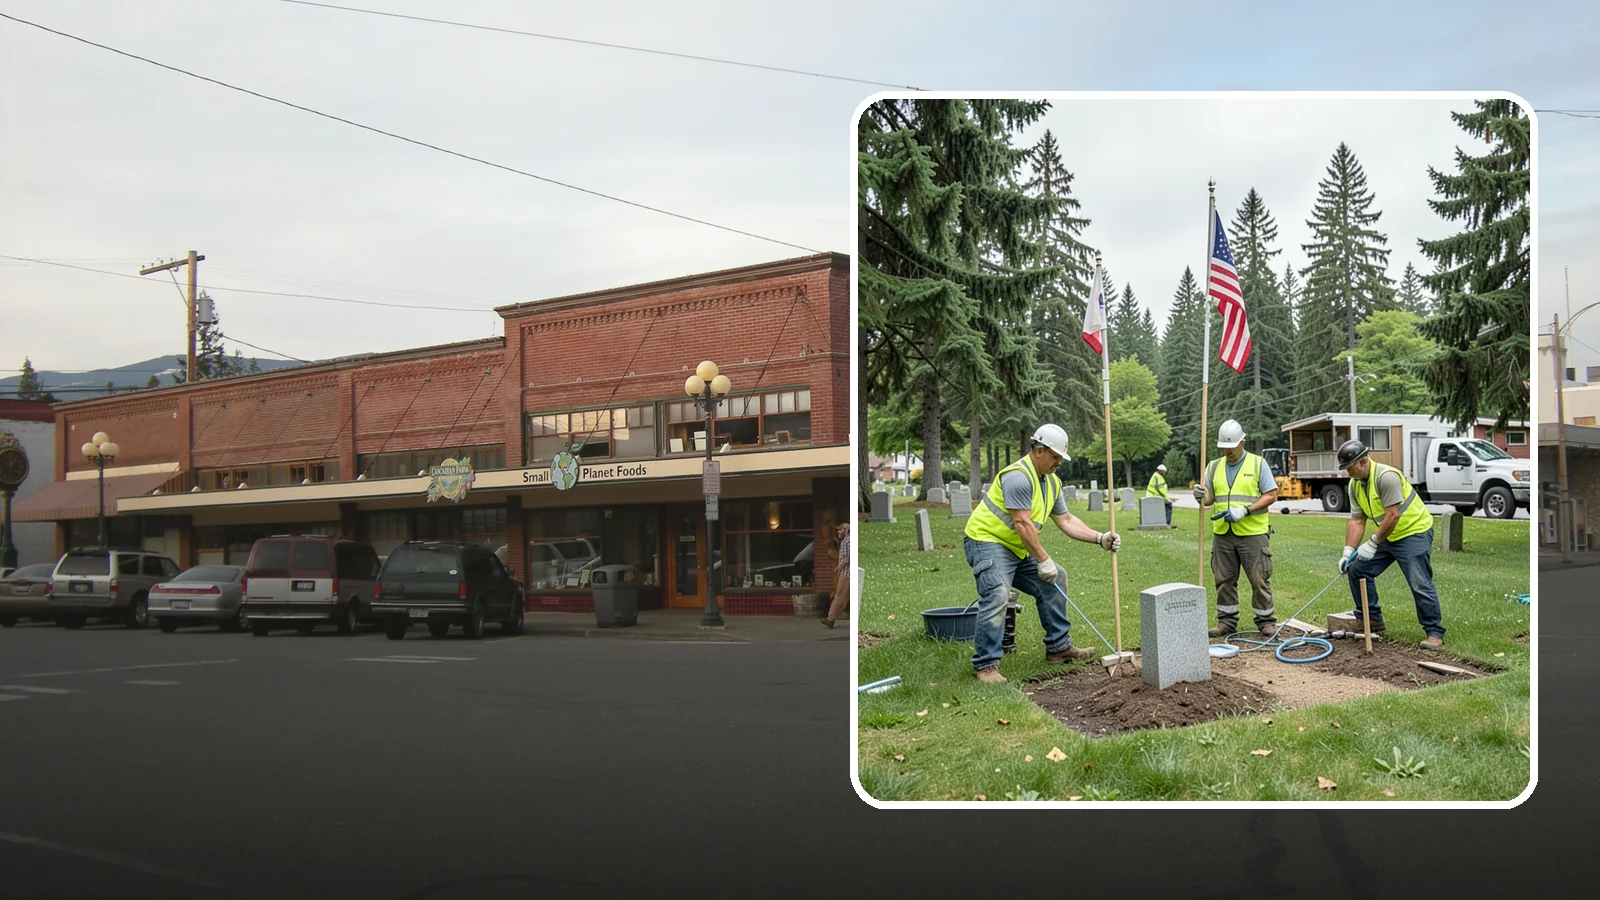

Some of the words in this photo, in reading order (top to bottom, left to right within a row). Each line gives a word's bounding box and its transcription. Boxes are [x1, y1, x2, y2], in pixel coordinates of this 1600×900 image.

[523, 471, 549, 483] Small
[583, 467, 614, 479] Planet
[617, 464, 647, 477] Foods
